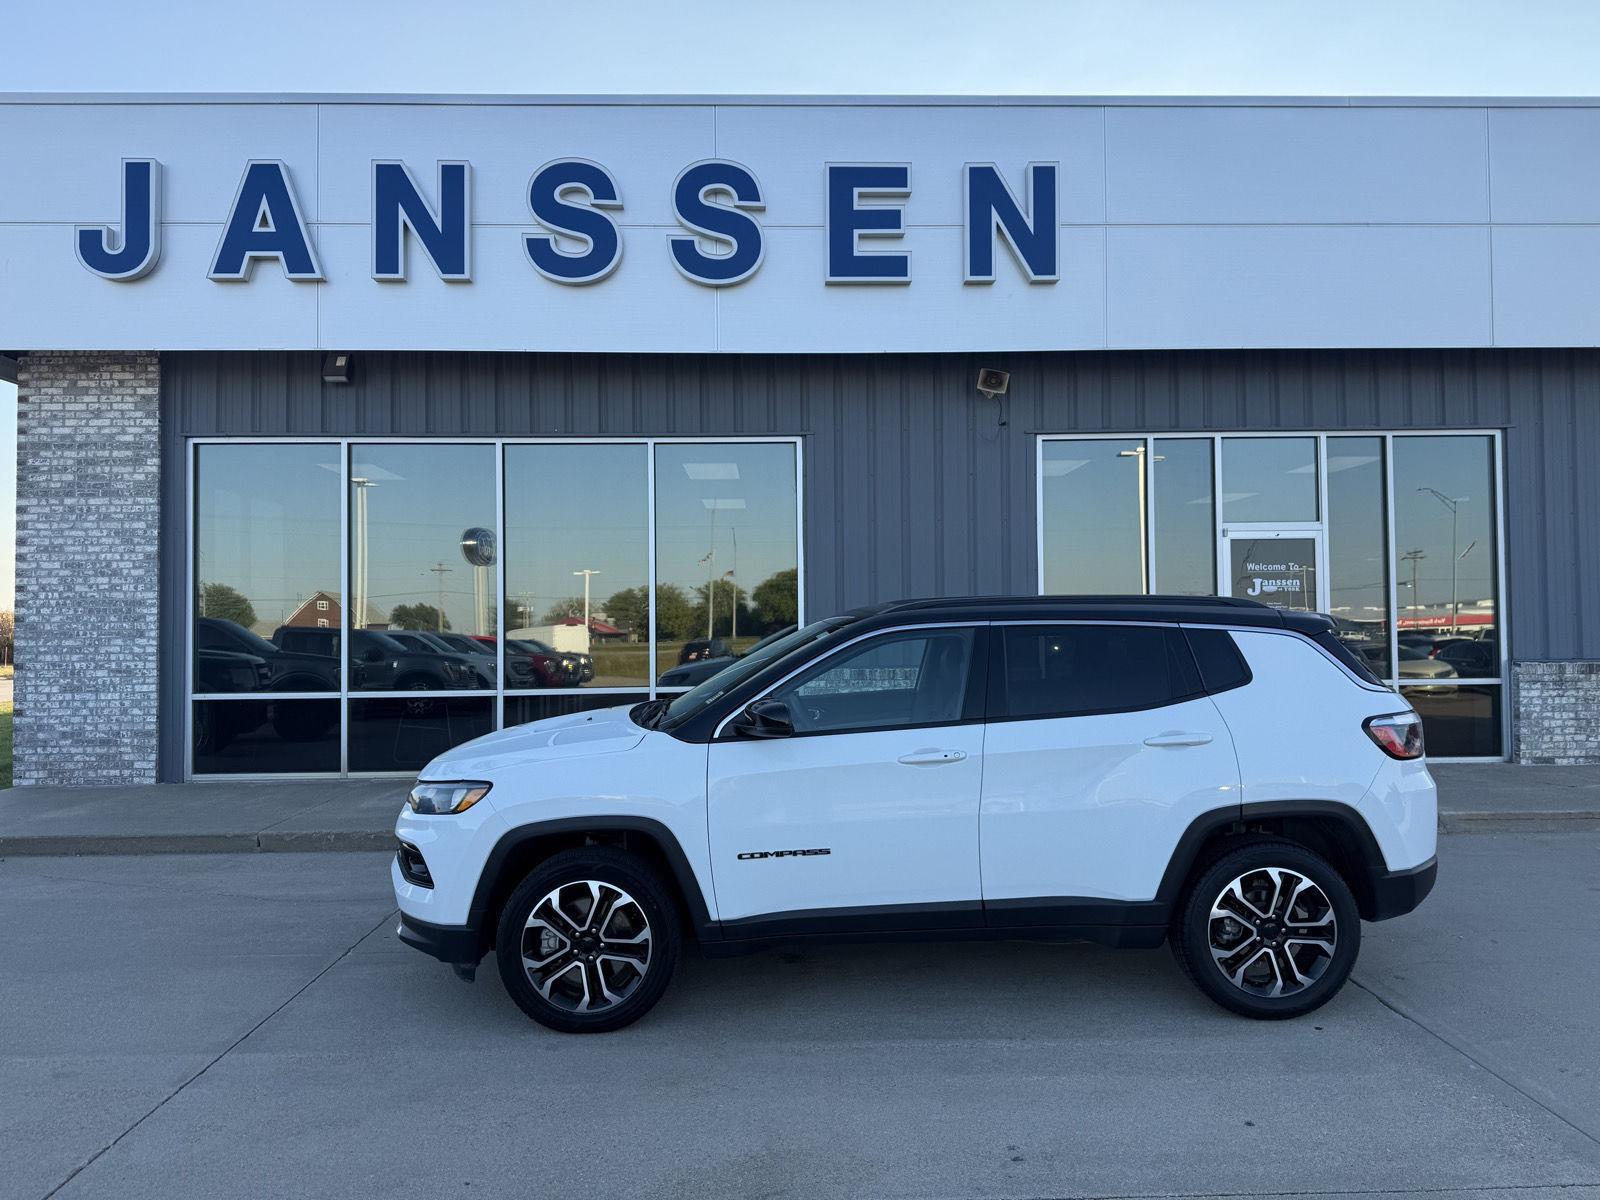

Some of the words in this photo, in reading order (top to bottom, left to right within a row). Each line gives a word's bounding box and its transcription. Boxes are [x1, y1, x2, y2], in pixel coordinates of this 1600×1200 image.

[75, 158, 1060, 286] JANSSEN
[1246, 562, 1286, 571] Welcome
[1288, 562, 1299, 571] To
[1247, 578, 1300, 596] Janssen
[737, 848, 831, 860] COMPASS
